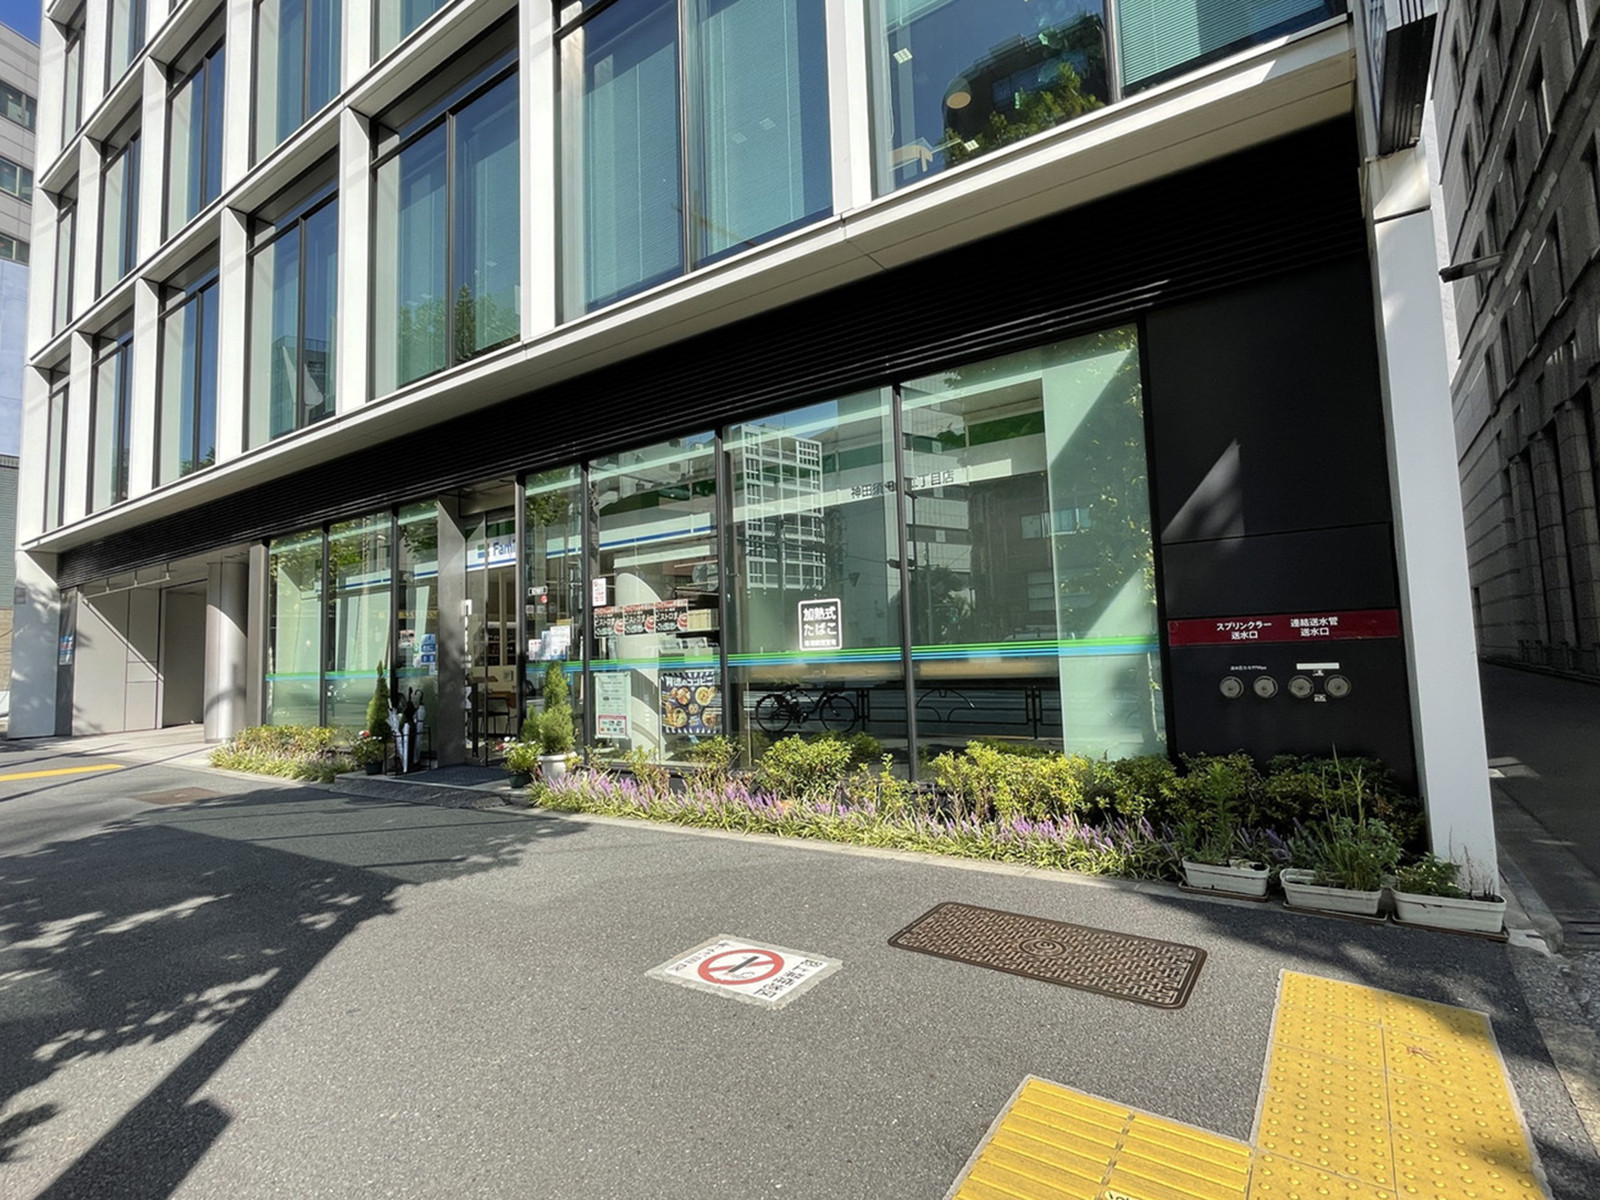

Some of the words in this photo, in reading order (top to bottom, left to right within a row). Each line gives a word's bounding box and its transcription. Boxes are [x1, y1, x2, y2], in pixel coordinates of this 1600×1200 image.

[803, 606, 836, 621] 加熱式
[1216, 621, 1272, 631] スプリンクラー
[1290, 617, 1338, 627] 連結送水管
[804, 622, 837, 636] たばこ
[1300, 627, 1330, 637] 送水口
[1231, 631, 1258, 640] 送水口
